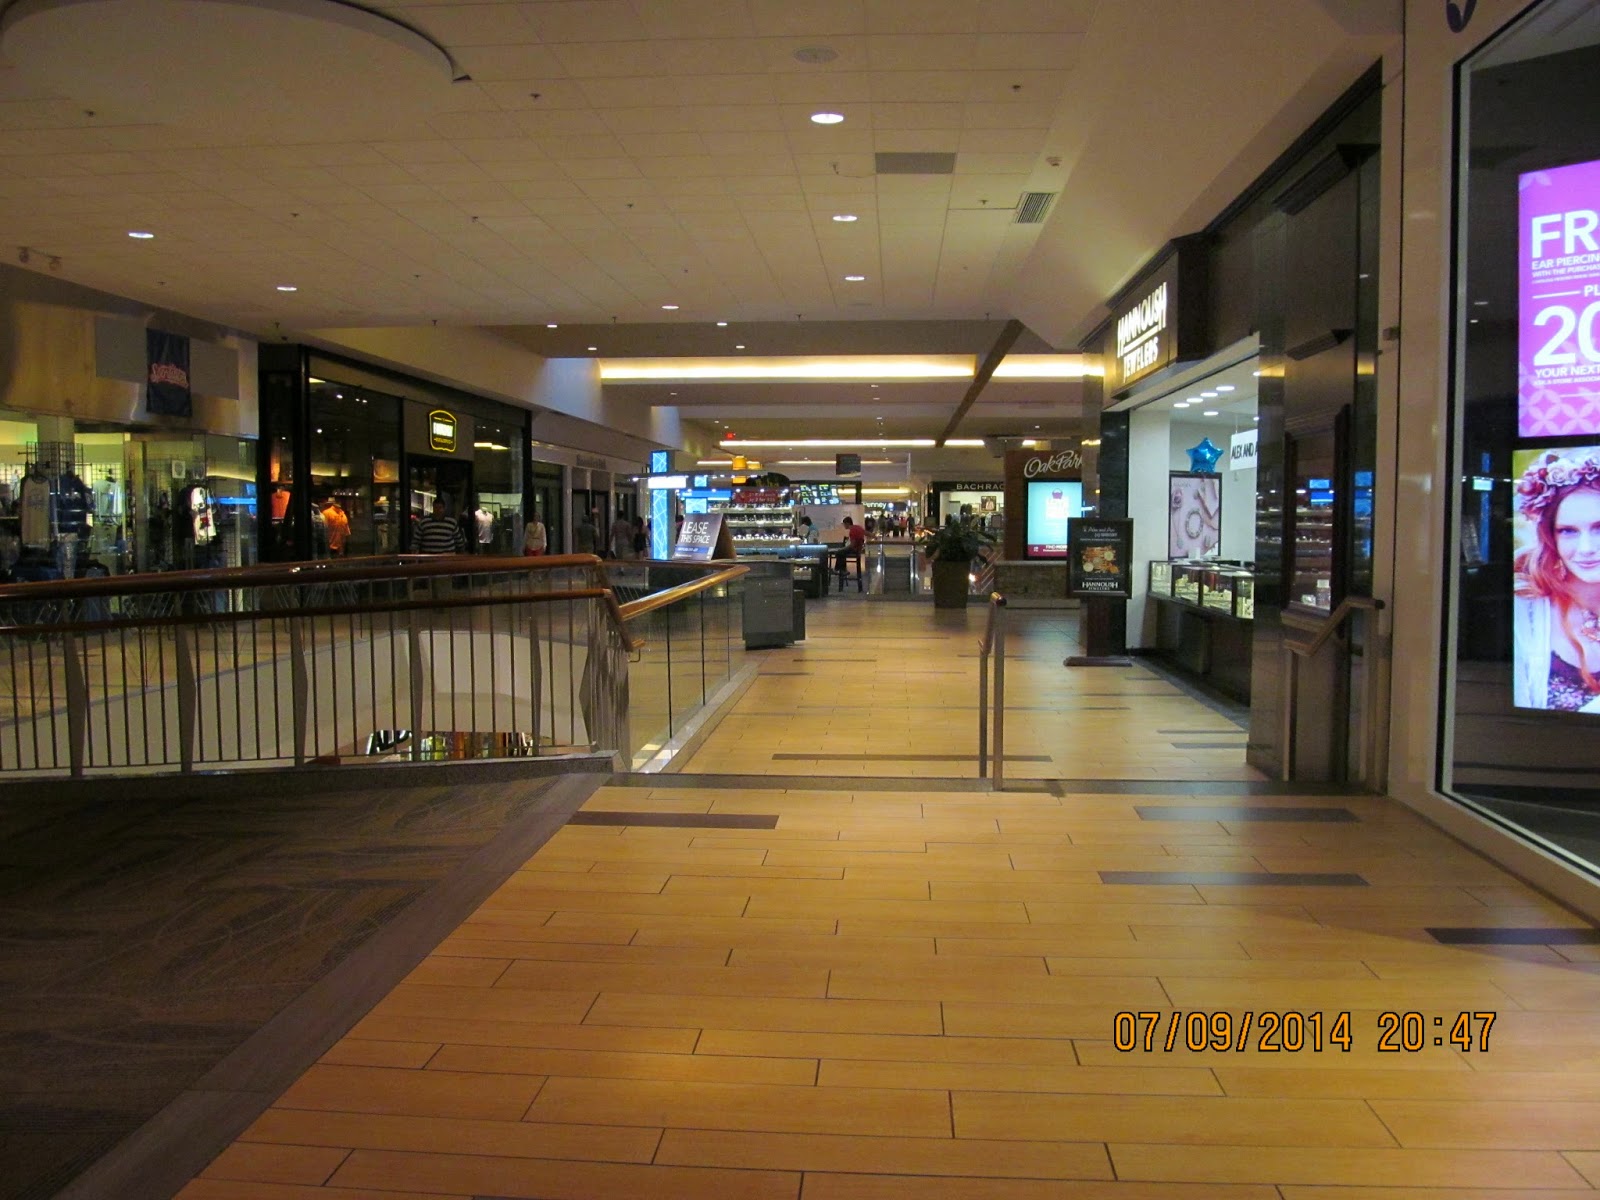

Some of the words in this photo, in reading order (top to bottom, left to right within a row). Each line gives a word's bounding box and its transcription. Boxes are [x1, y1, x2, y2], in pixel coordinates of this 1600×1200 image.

[1532, 259, 1554, 270] EAR
[1117, 281, 1167, 358] HANNOUSH
[1535, 367, 1568, 379] YOUR
[1024, 455, 1060, 478] Oak
[681, 521, 709, 534] LEASE
[680, 534, 692, 543] THIS
[692, 535, 710, 543] SPACE
